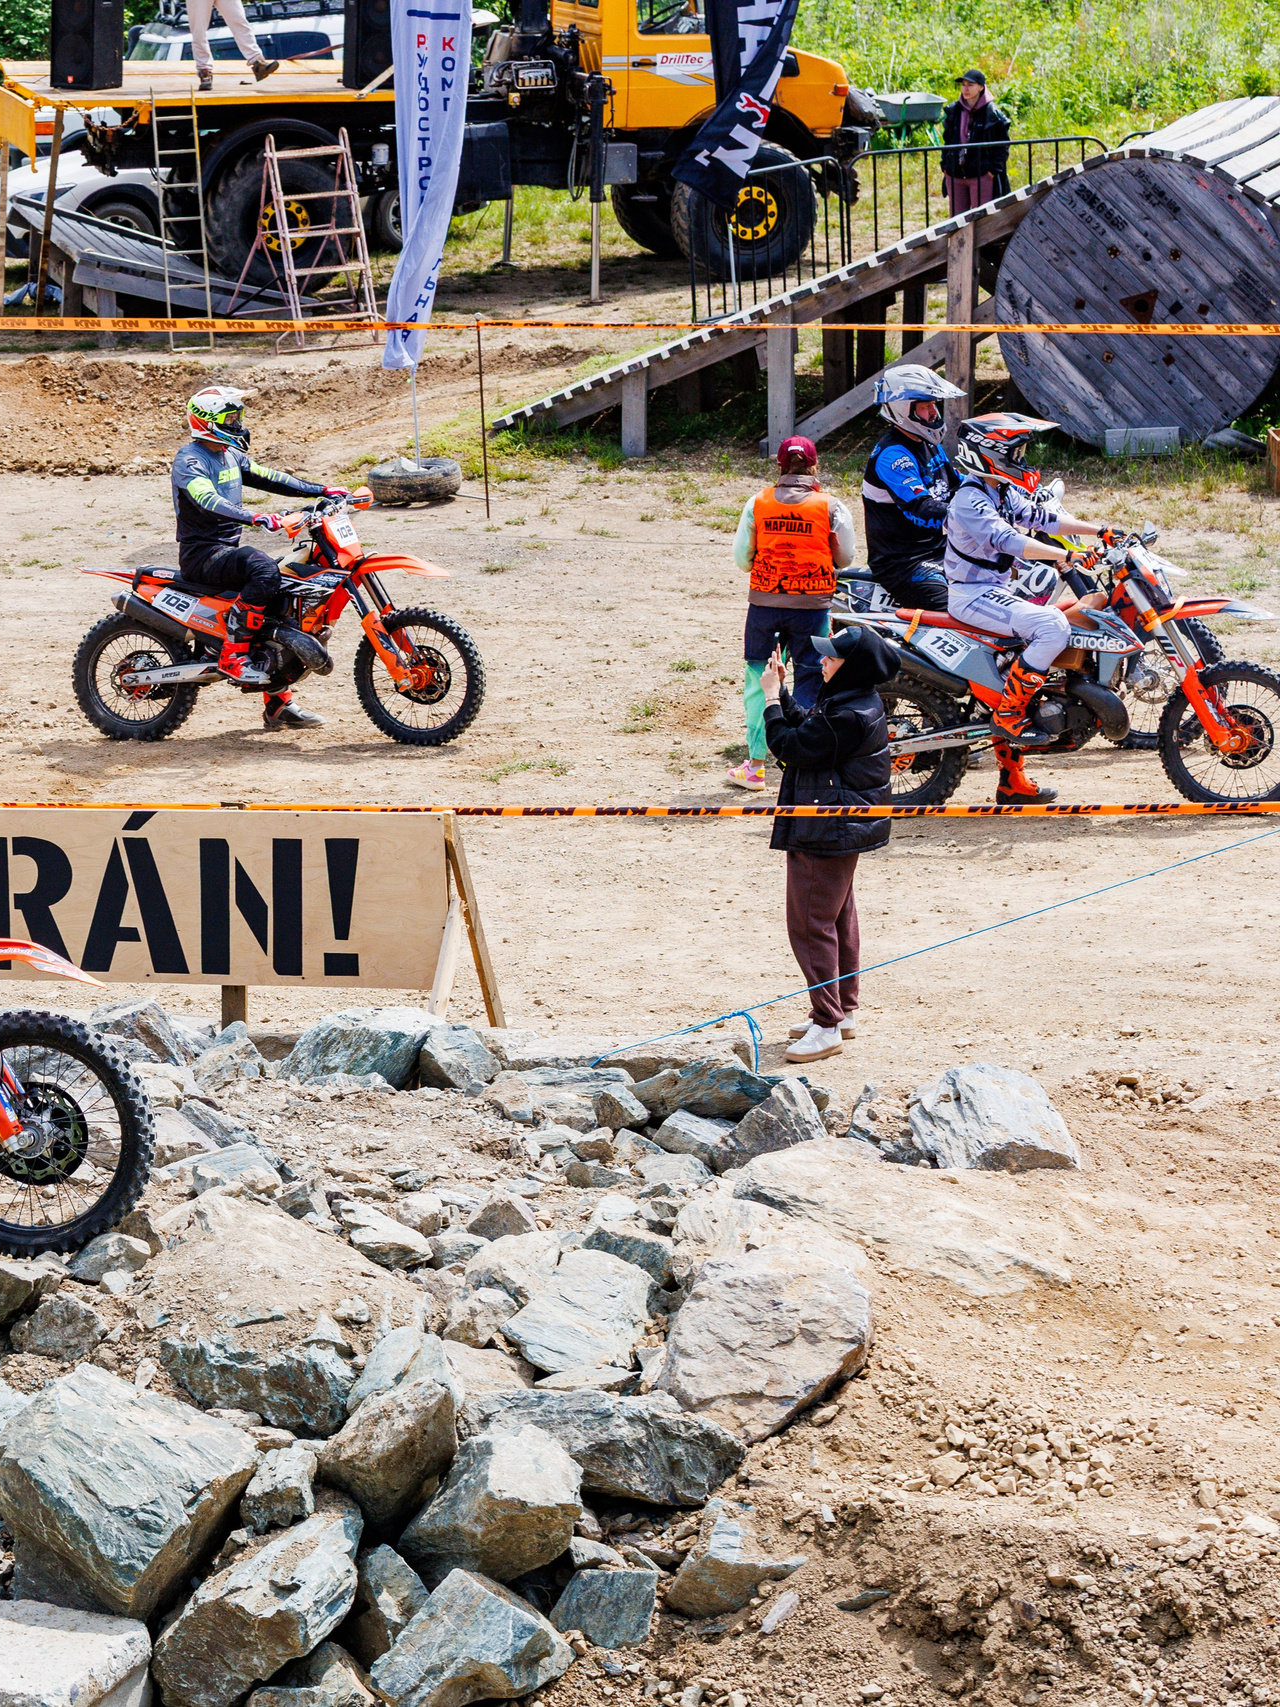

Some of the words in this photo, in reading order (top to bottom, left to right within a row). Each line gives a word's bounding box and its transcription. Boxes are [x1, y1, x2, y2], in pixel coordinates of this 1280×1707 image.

[660, 54, 704, 65] DrillTec
[191, 403, 218, 421] 100%
[965, 431, 1008, 455] 100%
[337, 525, 354, 539] 102
[764, 520, 813, 534] МАРШАЛ
[161, 593, 190, 613] 102
[930, 636, 960, 658] 113
[1069, 635, 1129, 651] rgrodeo
